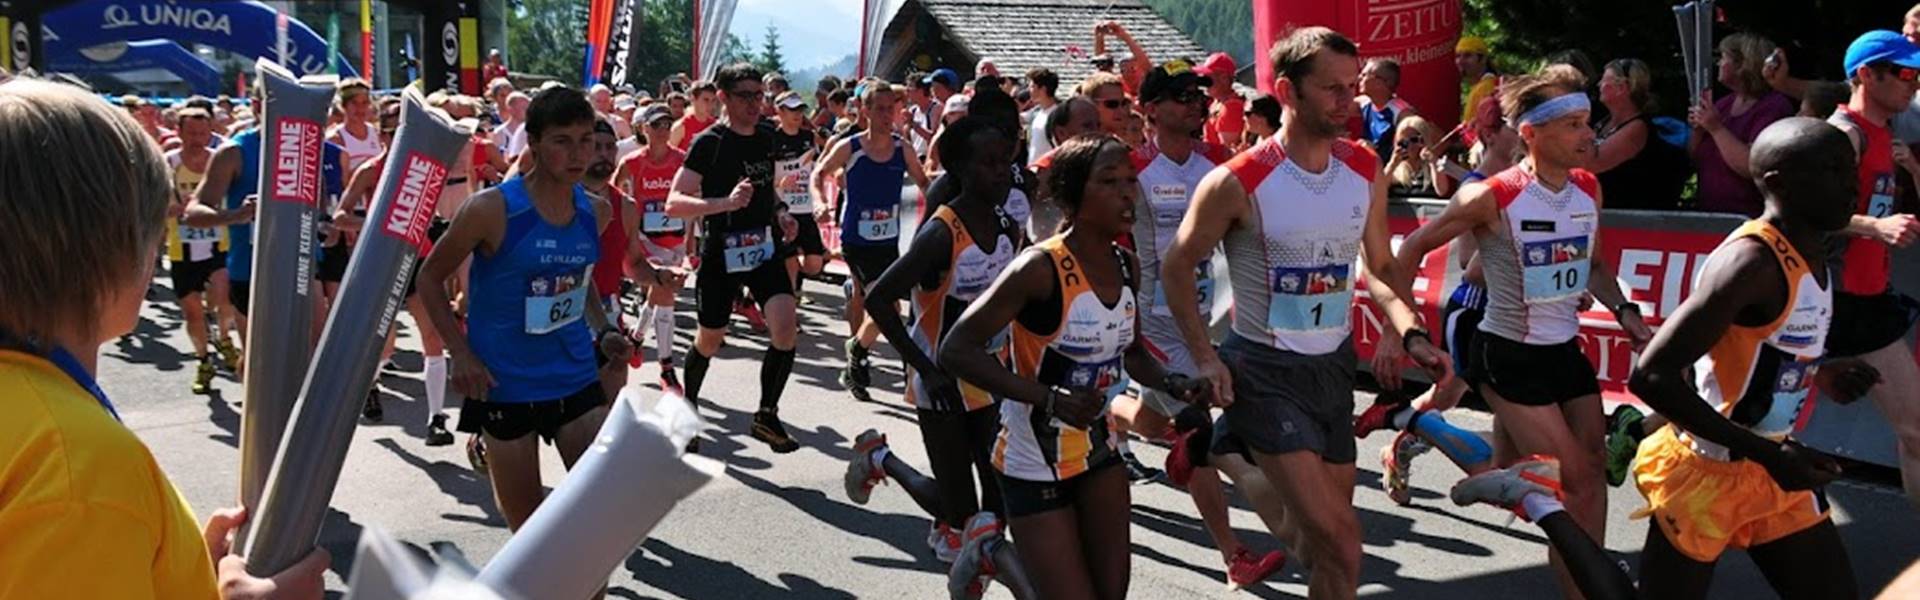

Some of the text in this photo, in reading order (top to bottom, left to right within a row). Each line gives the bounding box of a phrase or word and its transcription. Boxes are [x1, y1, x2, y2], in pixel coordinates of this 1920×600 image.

[140, 4, 231, 35] UNIQA
[276, 122, 301, 197] KLEINE
[302, 124, 319, 201] ZEITUNG
[387, 156, 431, 235] KLEINE
[410, 164, 446, 244] ZEITUNG
[872, 222, 889, 236] 97
[297, 256, 311, 296] MEINE
[1551, 268, 1578, 291] 10
[376, 296, 399, 339] MEINE
[549, 298, 573, 322] 62
[1310, 301, 1323, 326] 1
